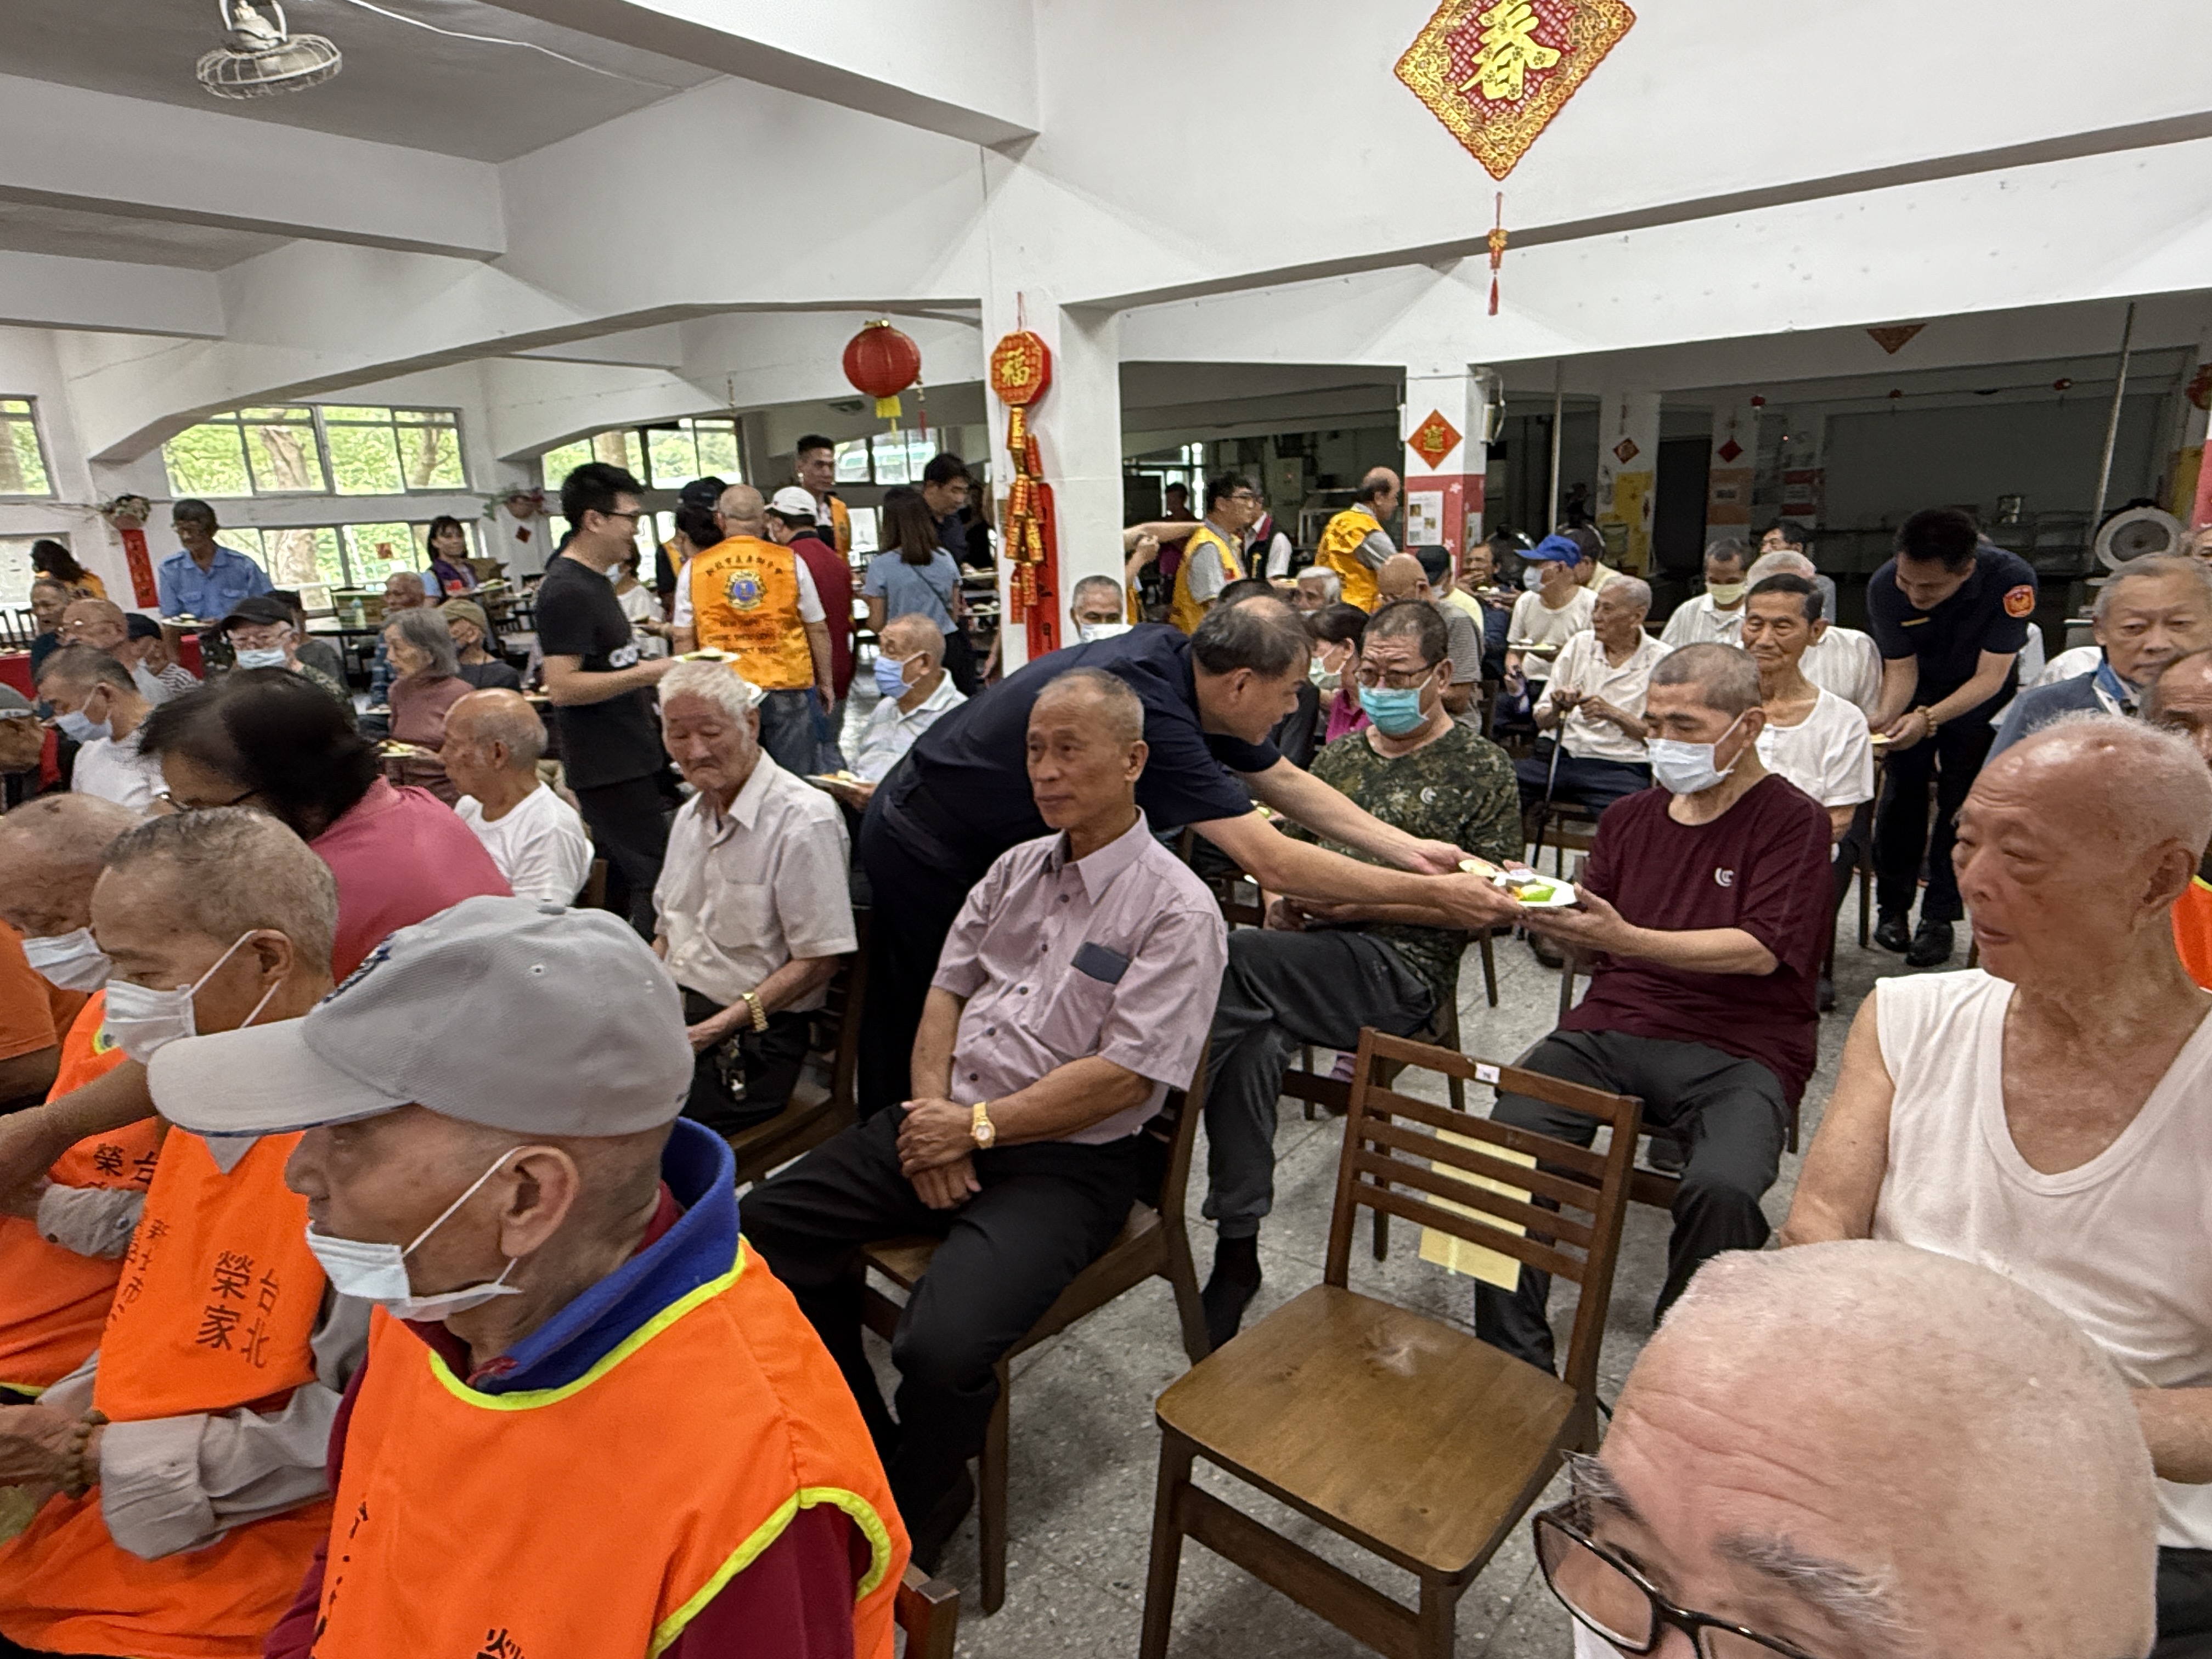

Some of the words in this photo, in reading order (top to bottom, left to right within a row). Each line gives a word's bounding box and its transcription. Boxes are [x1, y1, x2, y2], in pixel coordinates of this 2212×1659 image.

[1458, 0, 1562, 101] 春
[1001, 347, 1030, 387] 福
[195, 1250, 255, 1351] 榮家
[240, 1267, 280, 1368] 台北
